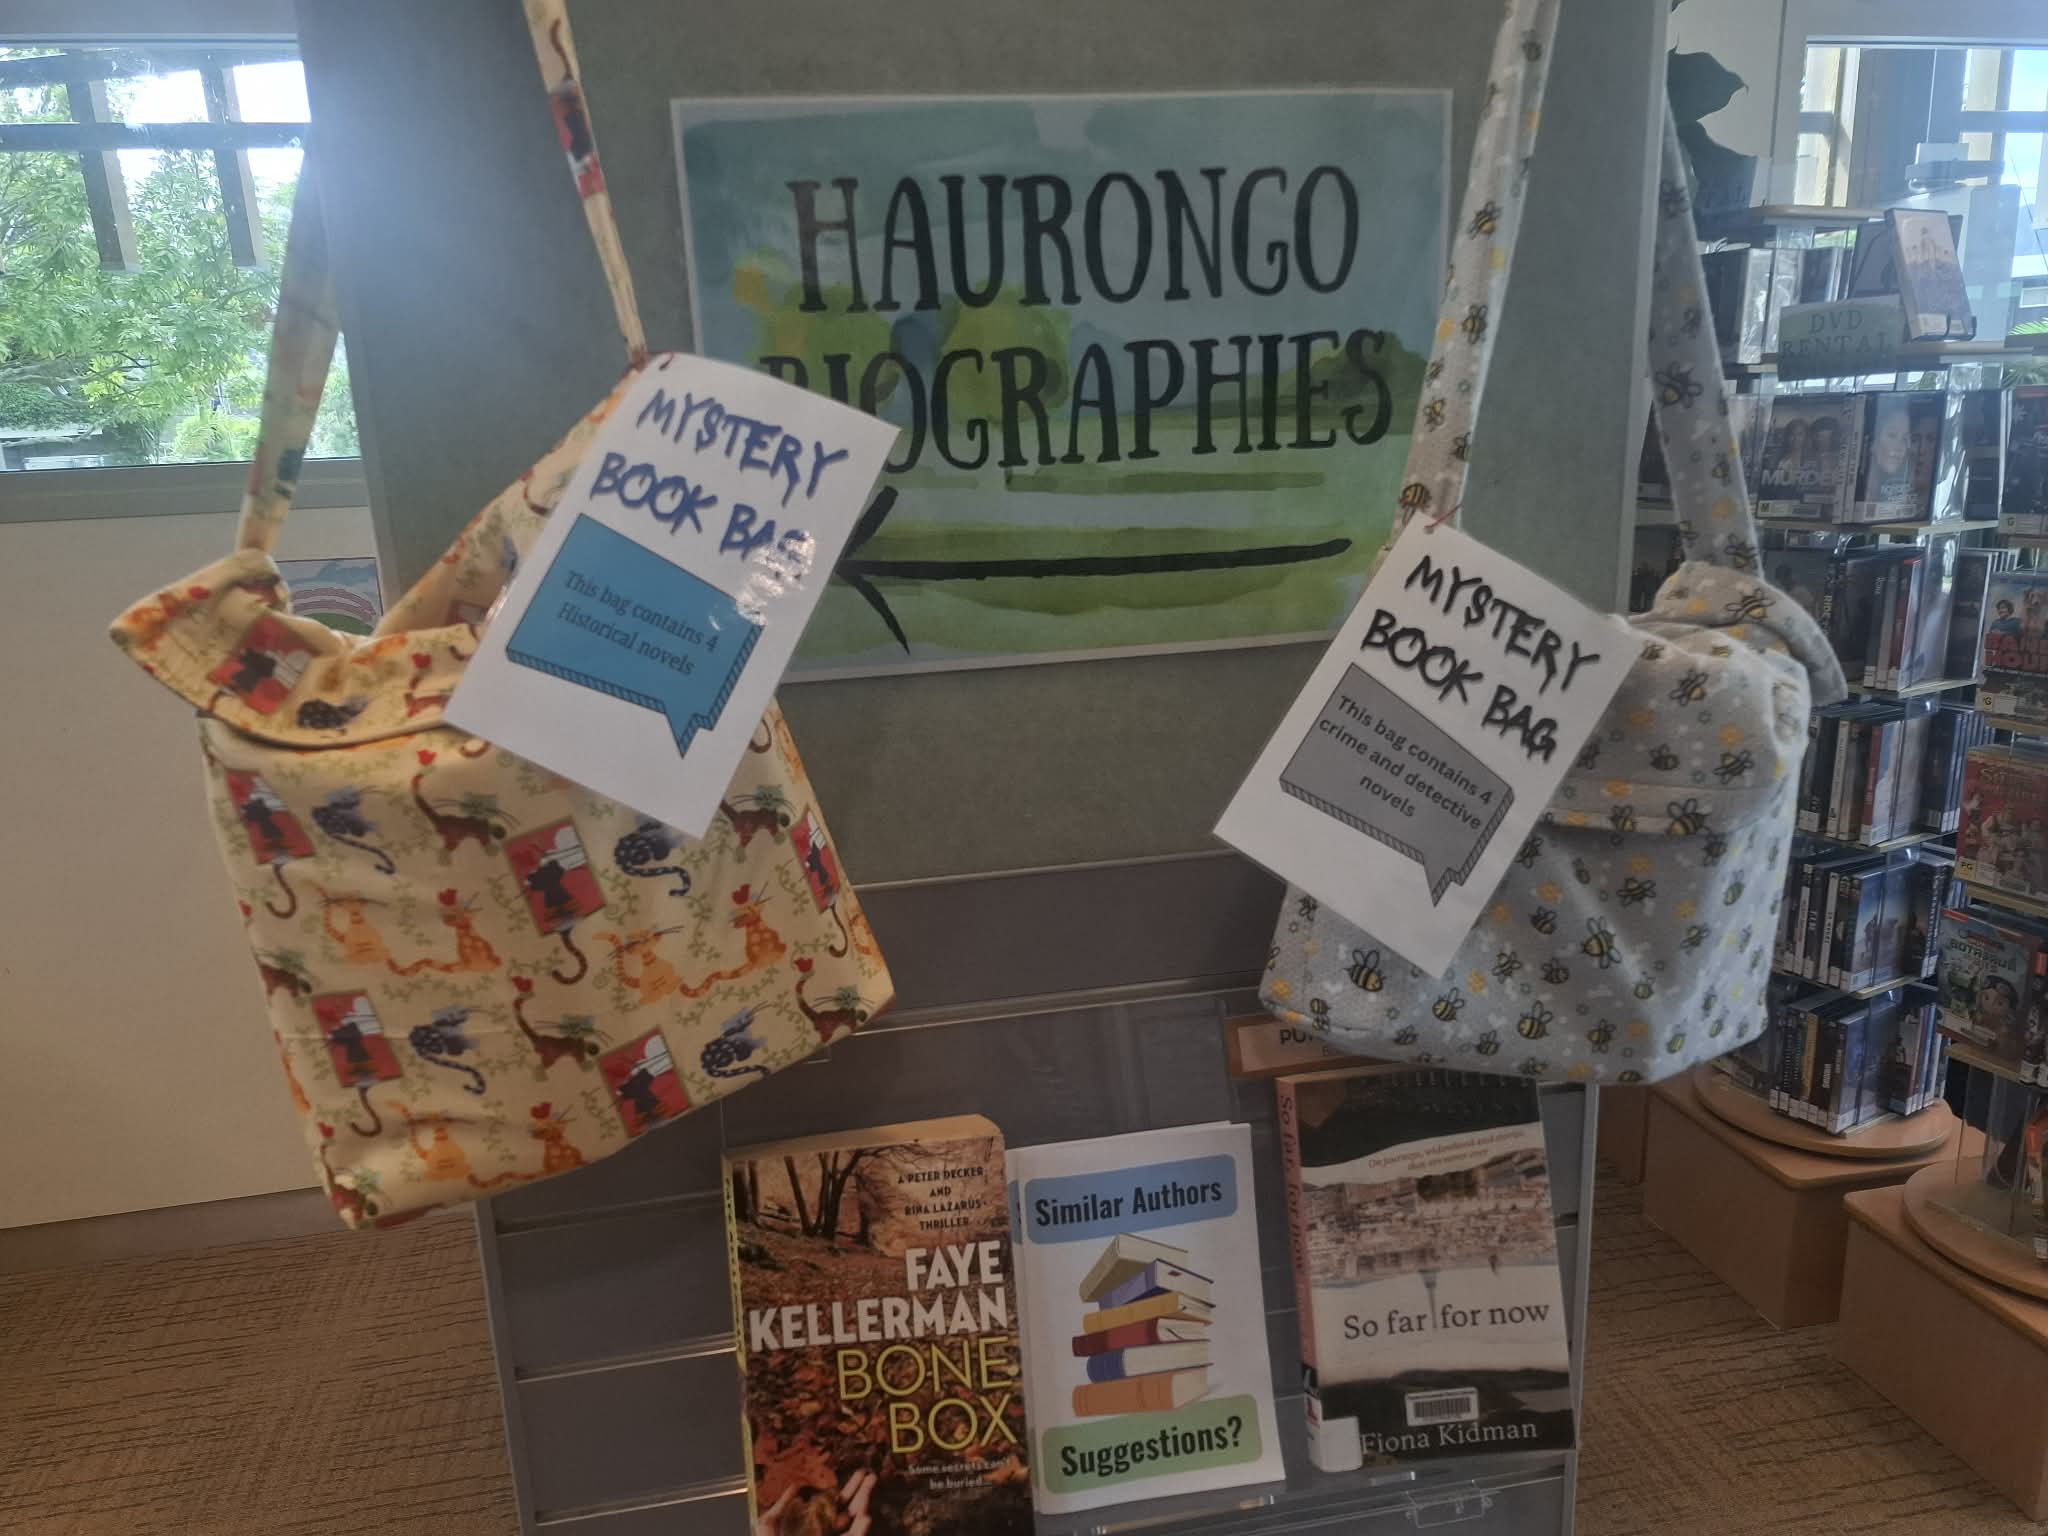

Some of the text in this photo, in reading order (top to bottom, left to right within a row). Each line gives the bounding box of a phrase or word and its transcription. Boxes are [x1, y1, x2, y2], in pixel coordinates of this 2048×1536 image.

[786, 165, 1360, 313] HAURONGO
[1782, 331, 1889, 357] RENTAL
[1809, 310, 1863, 334] DVD
[759, 329, 1393, 474] OGRAPHIES
[636, 388, 849, 507] MYSTERY
[590, 452, 718, 535] BOOK
[557, 603, 696, 677] Historical novels
[565, 570, 720, 655] This bag contains 4
[1405, 555, 1600, 694] MYSTERY
[1361, 609, 1559, 763] BOOK BAG
[1318, 717, 1482, 831] crime and detective
[1338, 695, 1494, 805] This bag contains 4
[1358, 772, 1417, 819] novels
[906, 1169, 941, 1184] PETER
[943, 1166, 985, 1180] DECKER
[929, 1186, 952, 1198] AND
[1035, 1180, 1223, 1227] Similar Authors
[904, 1199, 982, 1217] RINA LAZARUS
[919, 1217, 970, 1231] THRILLER
[905, 1240, 1004, 1292] FAYE
[748, 1286, 1008, 1353] KELLERMAN
[1343, 1303, 1550, 1340] So far for now
[836, 1336, 1014, 1401] BONE
[889, 1393, 1018, 1455] BOX
[1060, 1414, 1244, 1478] Suggestions?
[1360, 1417, 1538, 1455] Fiona Kidman
